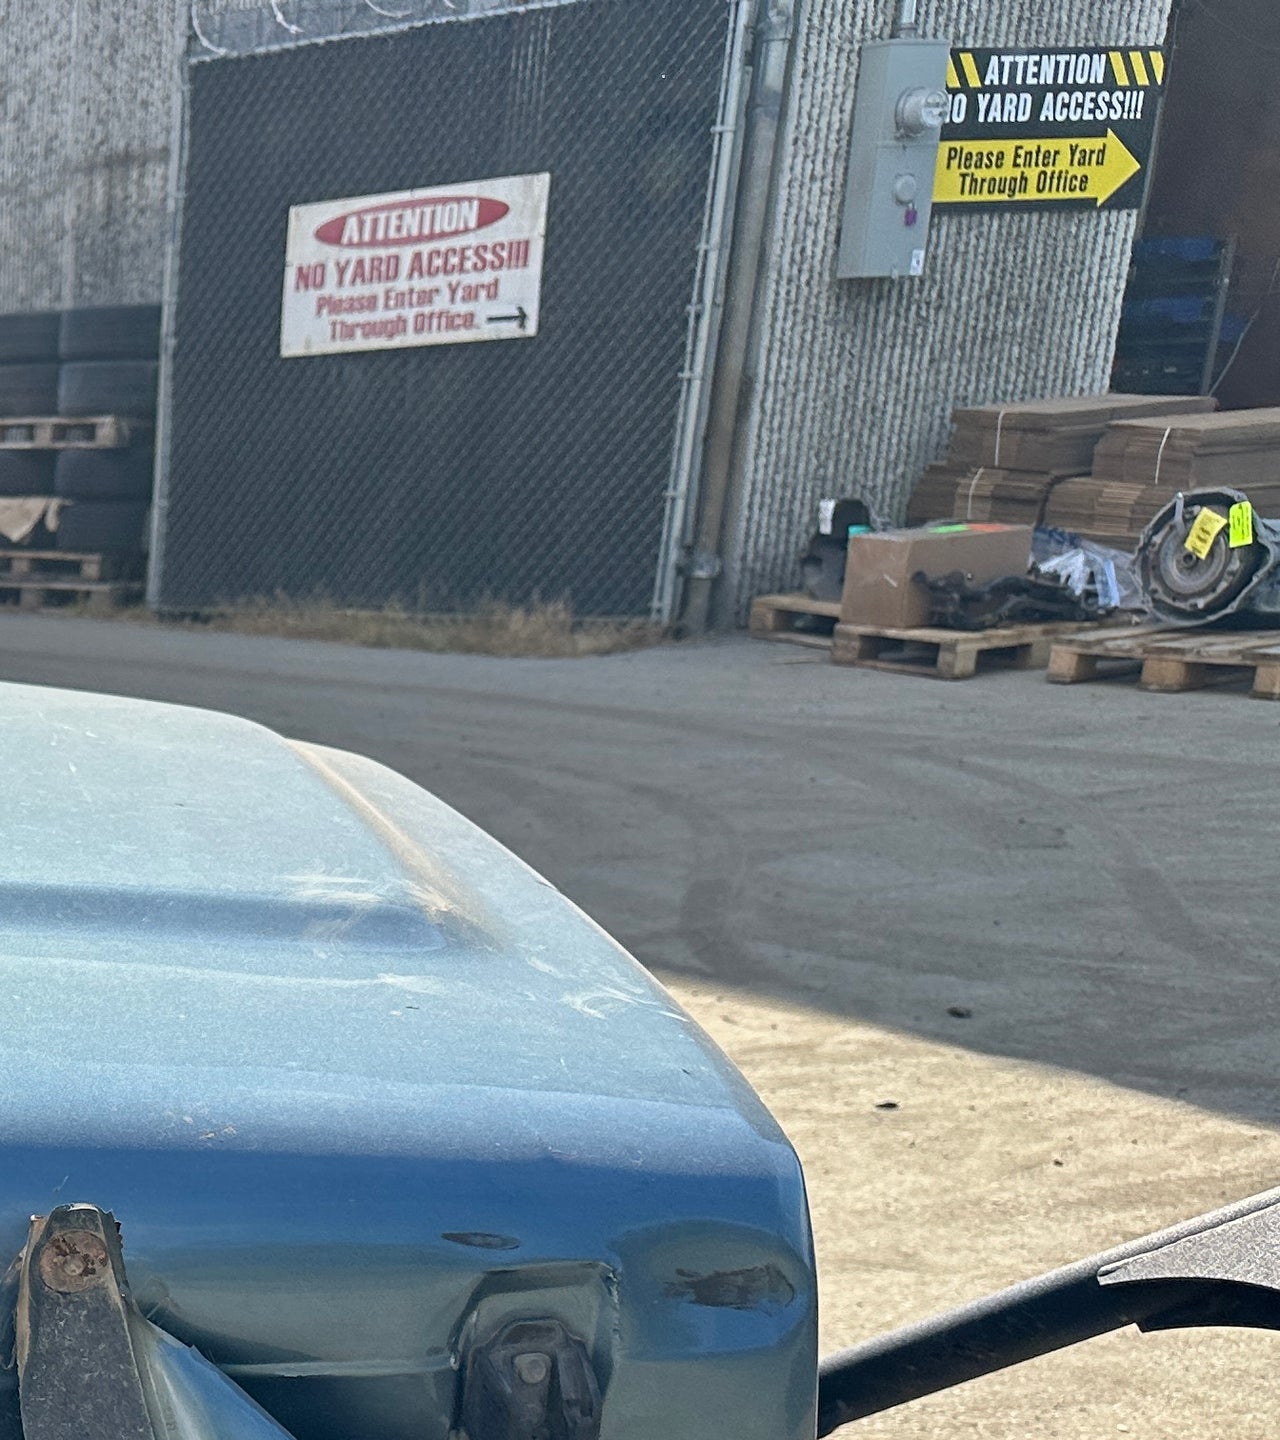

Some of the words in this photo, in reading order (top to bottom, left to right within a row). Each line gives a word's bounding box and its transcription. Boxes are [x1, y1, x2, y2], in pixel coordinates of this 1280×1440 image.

[984, 53, 1107, 86] ATTENTION
[977, 92, 1032, 123] YARD
[1040, 91, 1144, 121] ACCESS!!!
[946, 147, 1004, 170] Please
[1012, 146, 1060, 168] Enter
[1069, 144, 1106, 167] Yard
[959, 172, 1027, 198] Through
[1036, 170, 1089, 194] Office
[341, 200, 479, 245] ATTENTION
[295, 264, 325, 292] NO
[336, 254, 399, 287] YARD
[407, 240, 529, 281] ACCESS!!!
[316, 292, 377, 317] Please
[383, 287, 439, 310] Enter
[448, 279, 499, 304] Yard
[329, 314, 407, 341] Through
[414, 309, 475, 334] Office
